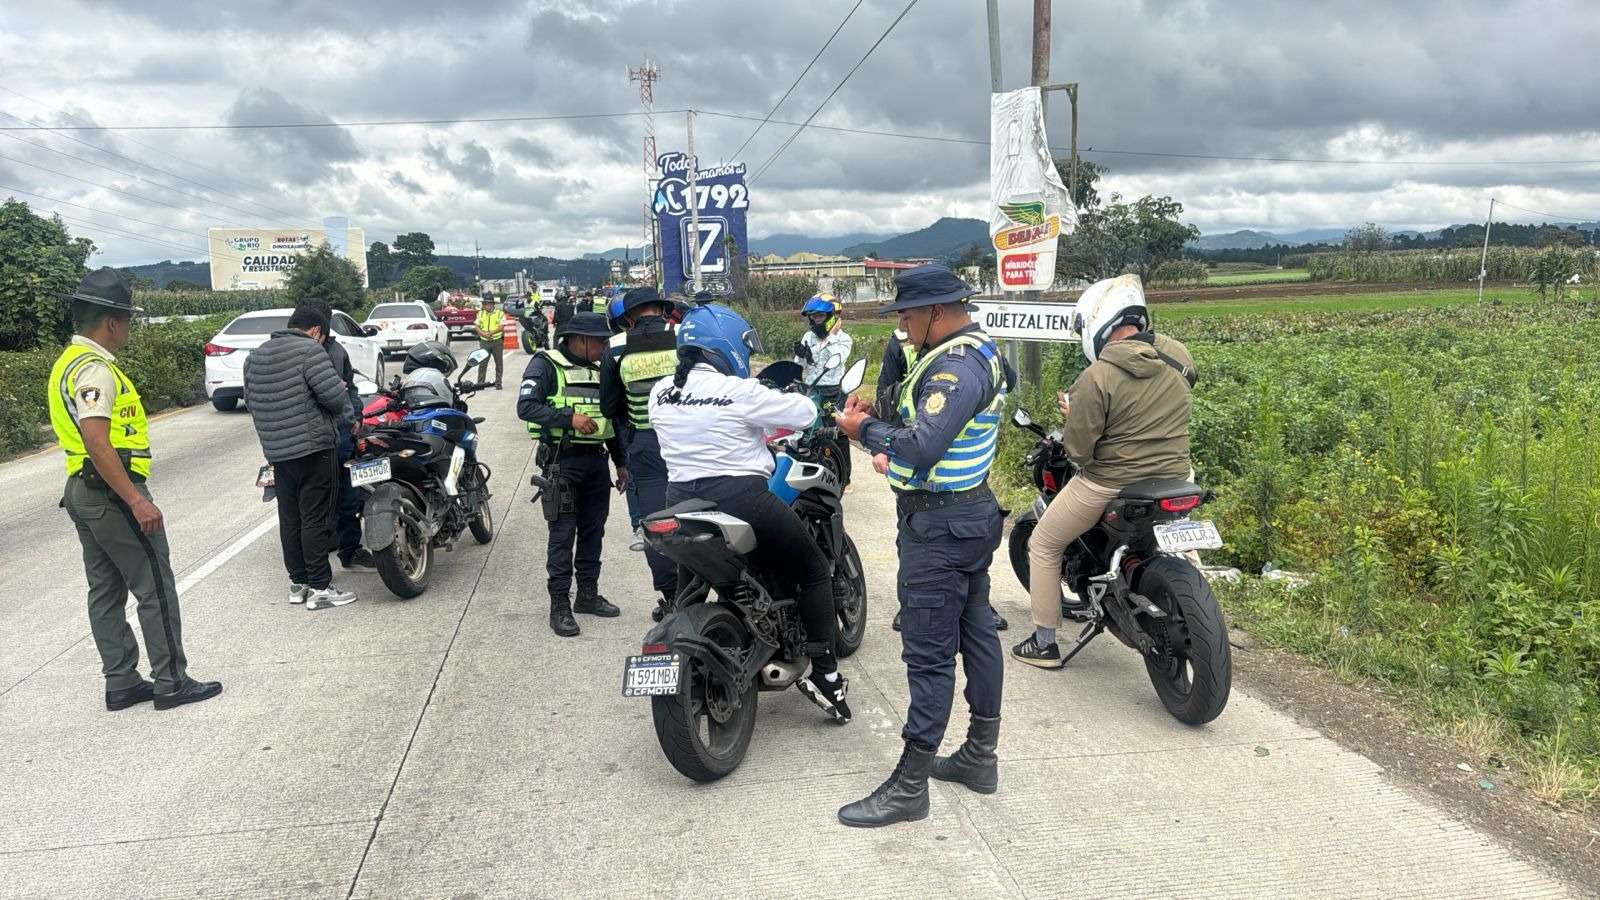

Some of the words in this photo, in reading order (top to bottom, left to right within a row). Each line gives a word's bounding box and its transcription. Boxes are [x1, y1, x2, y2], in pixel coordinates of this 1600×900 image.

[686, 164, 735, 183] lamamos
[680, 184, 749, 210] 1792
[243, 256, 296, 266] CALIDAD
[1005, 270, 1023, 279] PARA
[986, 311, 1071, 332] QUETZALTEN
[120, 405, 137, 418] CIV
[642, 654, 672, 662] CFMOTO
[633, 686, 677, 696] CFMOTO
